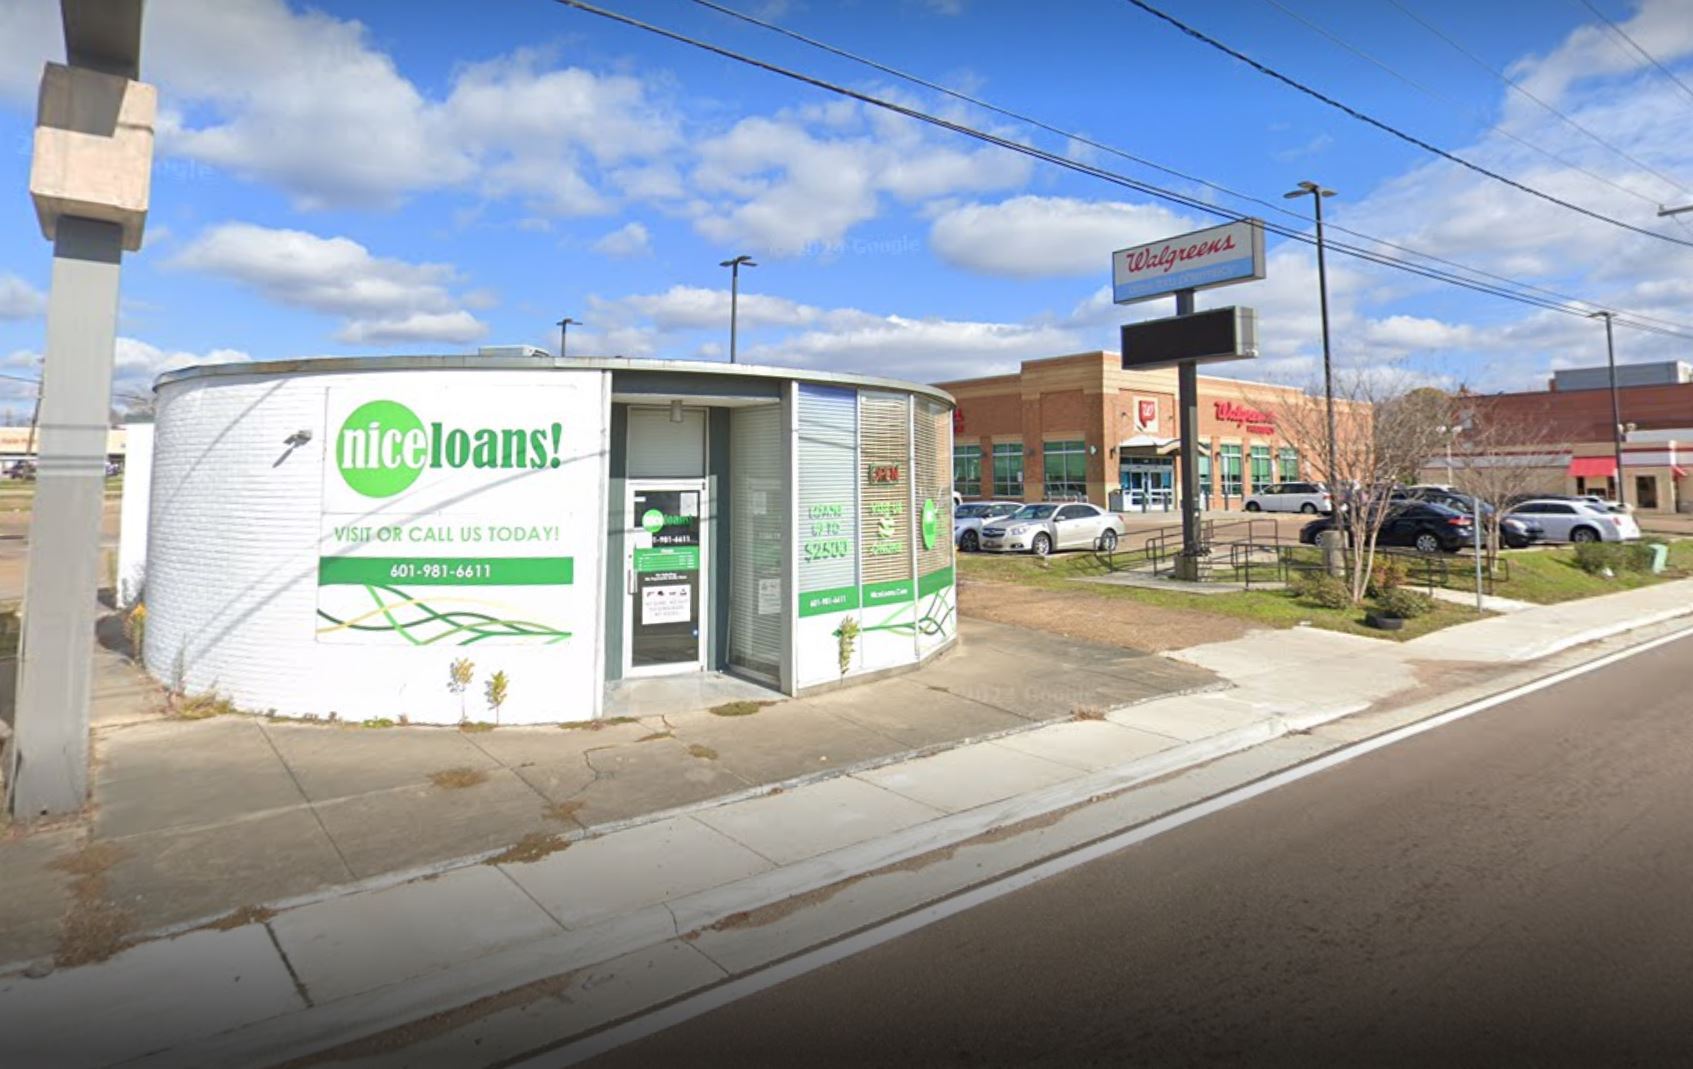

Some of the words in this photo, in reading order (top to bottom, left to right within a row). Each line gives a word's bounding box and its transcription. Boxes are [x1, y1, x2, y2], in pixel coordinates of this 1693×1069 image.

[1126, 235, 1235, 273] Walgreens
[334, 526, 372, 542] VISIT
[376, 526, 403, 542] OR
[408, 526, 454, 542] CALL
[460, 526, 482, 542] US
[487, 526, 560, 542] TODAY!
[389, 563, 492, 578] 601-981-6611
